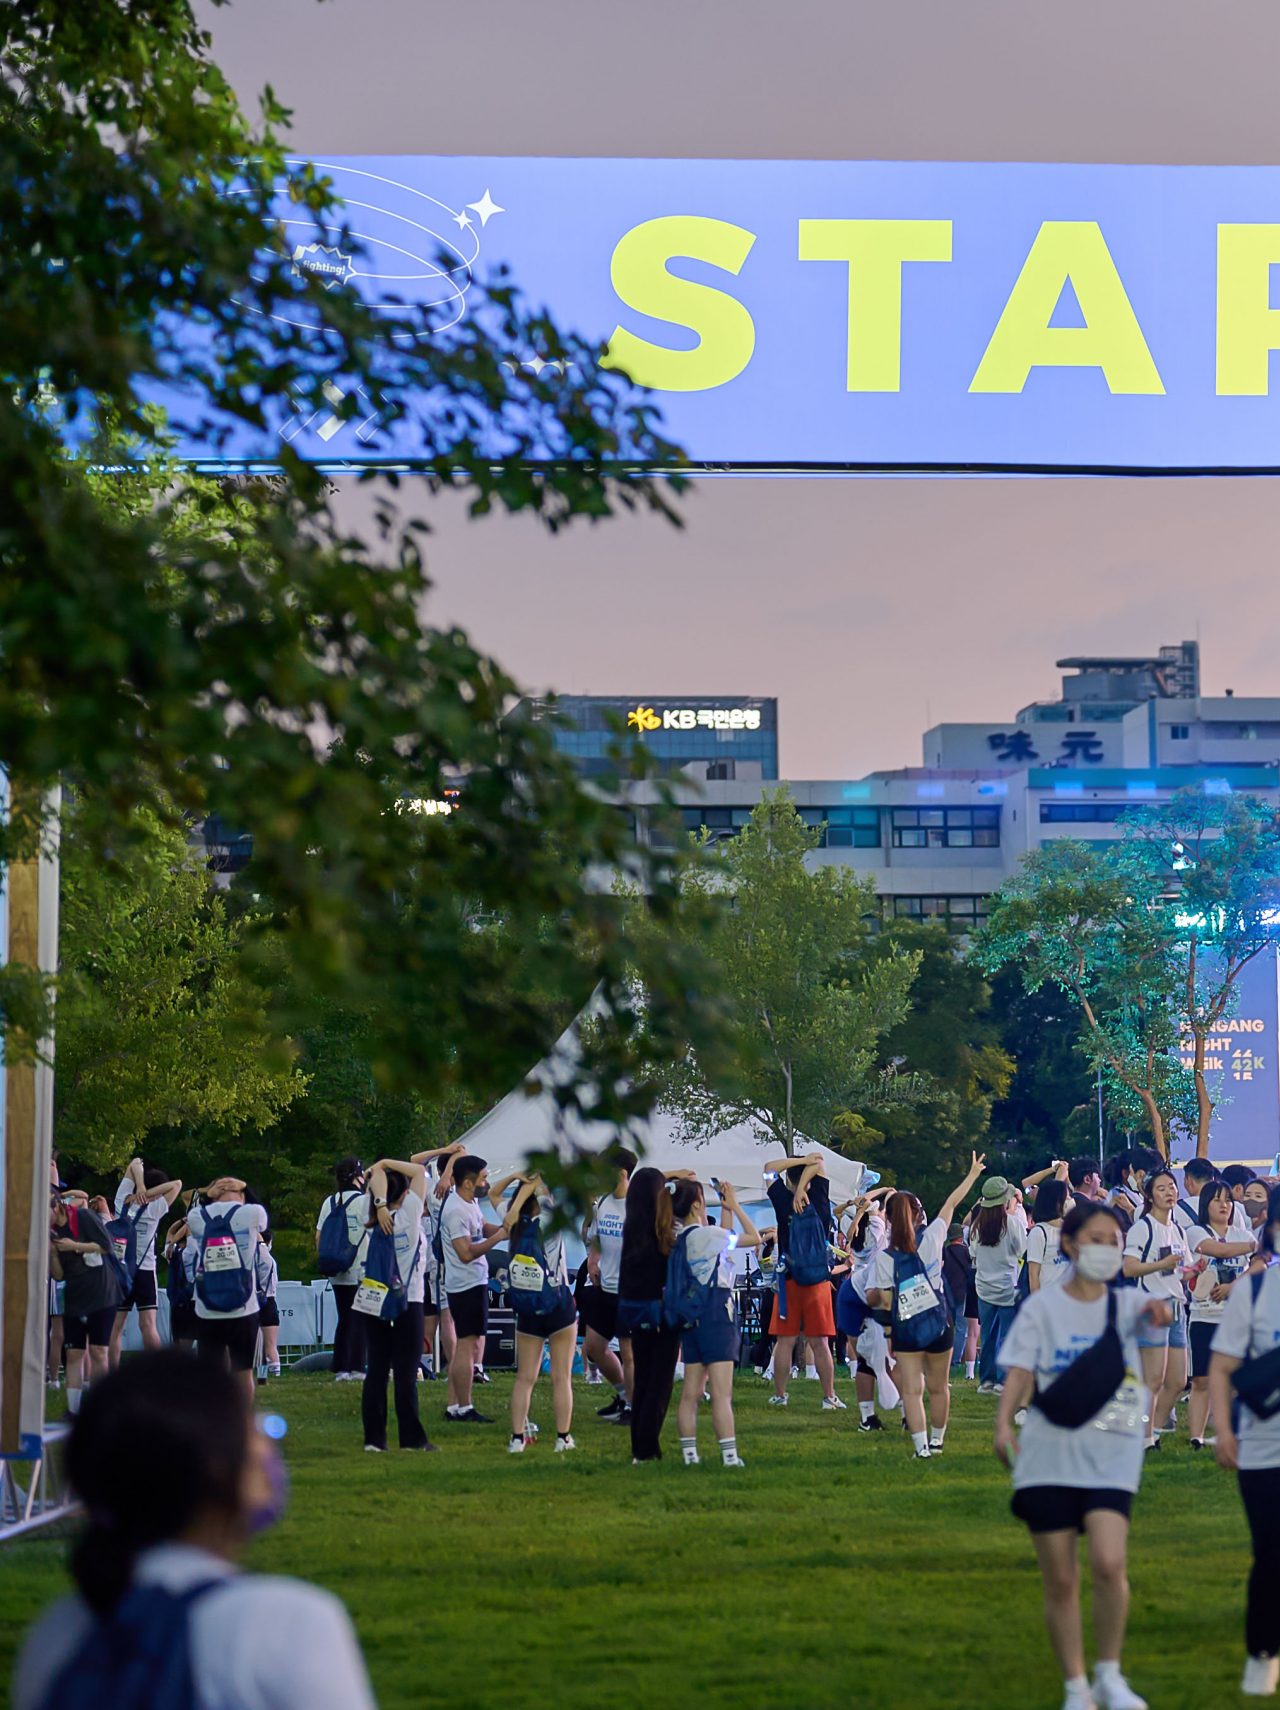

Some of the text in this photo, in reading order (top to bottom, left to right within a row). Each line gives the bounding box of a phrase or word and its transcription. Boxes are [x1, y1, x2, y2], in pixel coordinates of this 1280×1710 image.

[987, 730, 1104, 762] 味元
[1231, 1057, 1265, 1071] 42K
[512, 1264, 540, 1279] C 20:00
[899, 1294, 908, 1304] B
